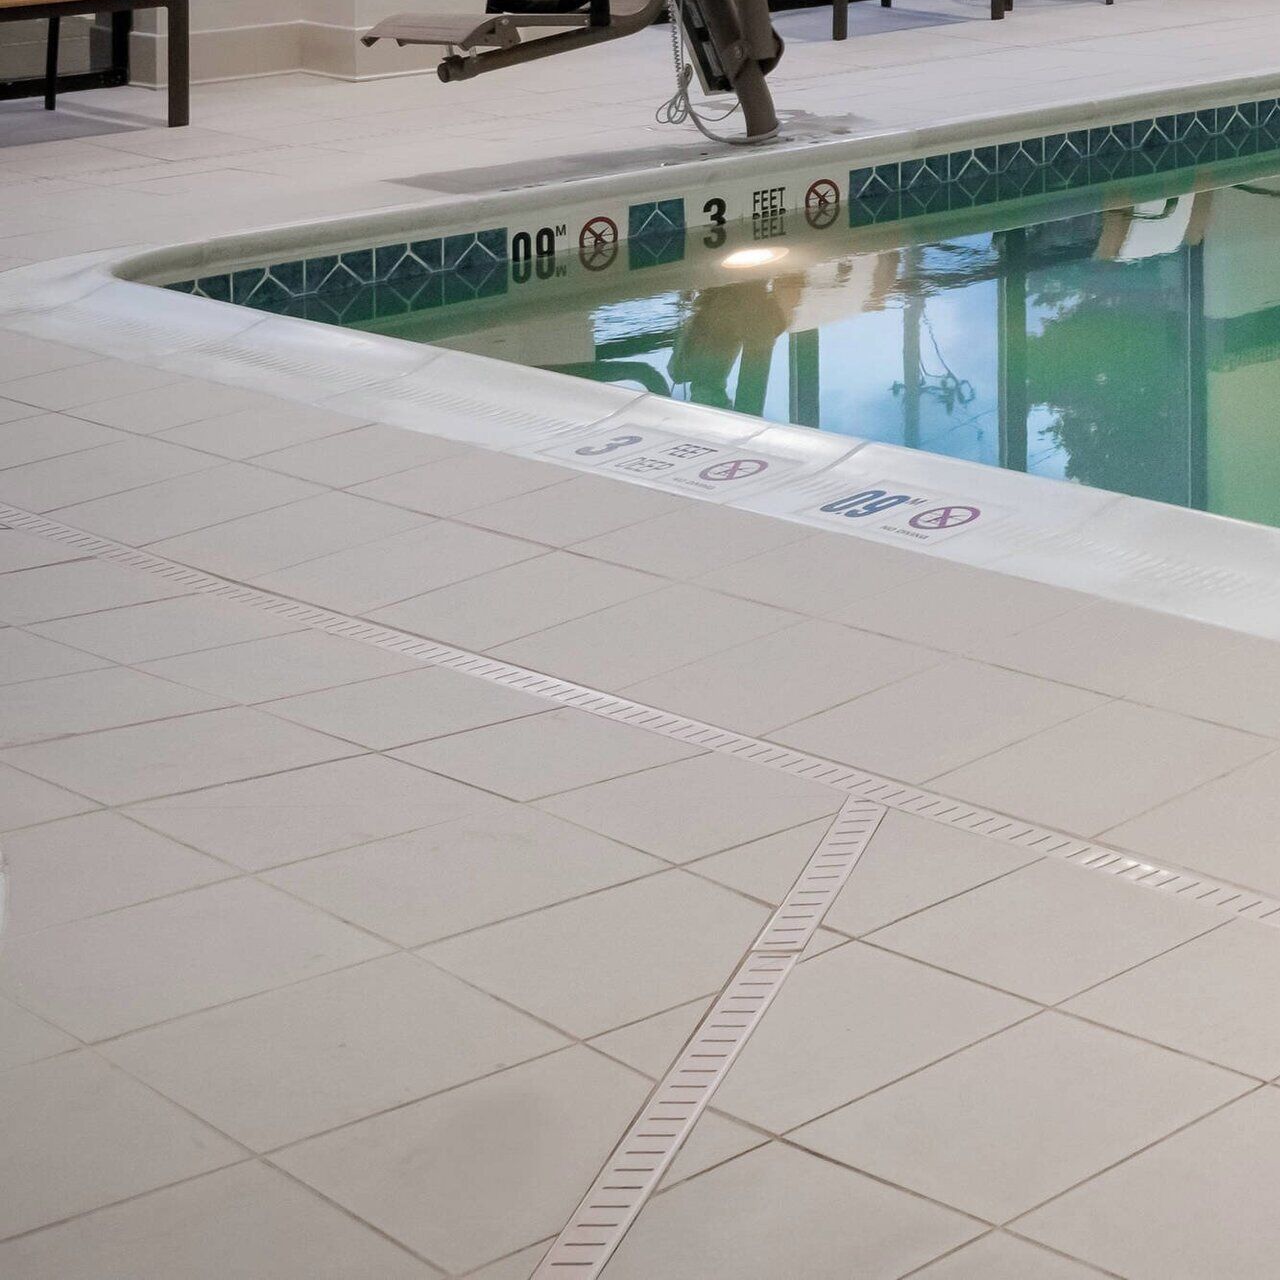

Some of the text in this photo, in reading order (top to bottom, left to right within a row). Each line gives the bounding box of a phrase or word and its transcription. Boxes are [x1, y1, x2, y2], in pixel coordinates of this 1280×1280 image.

[703, 198, 727, 226] 3
[753, 187, 786, 211] FEET
[575, 436, 719, 460] 3 FEET
[615, 457, 675, 472] DEEP
